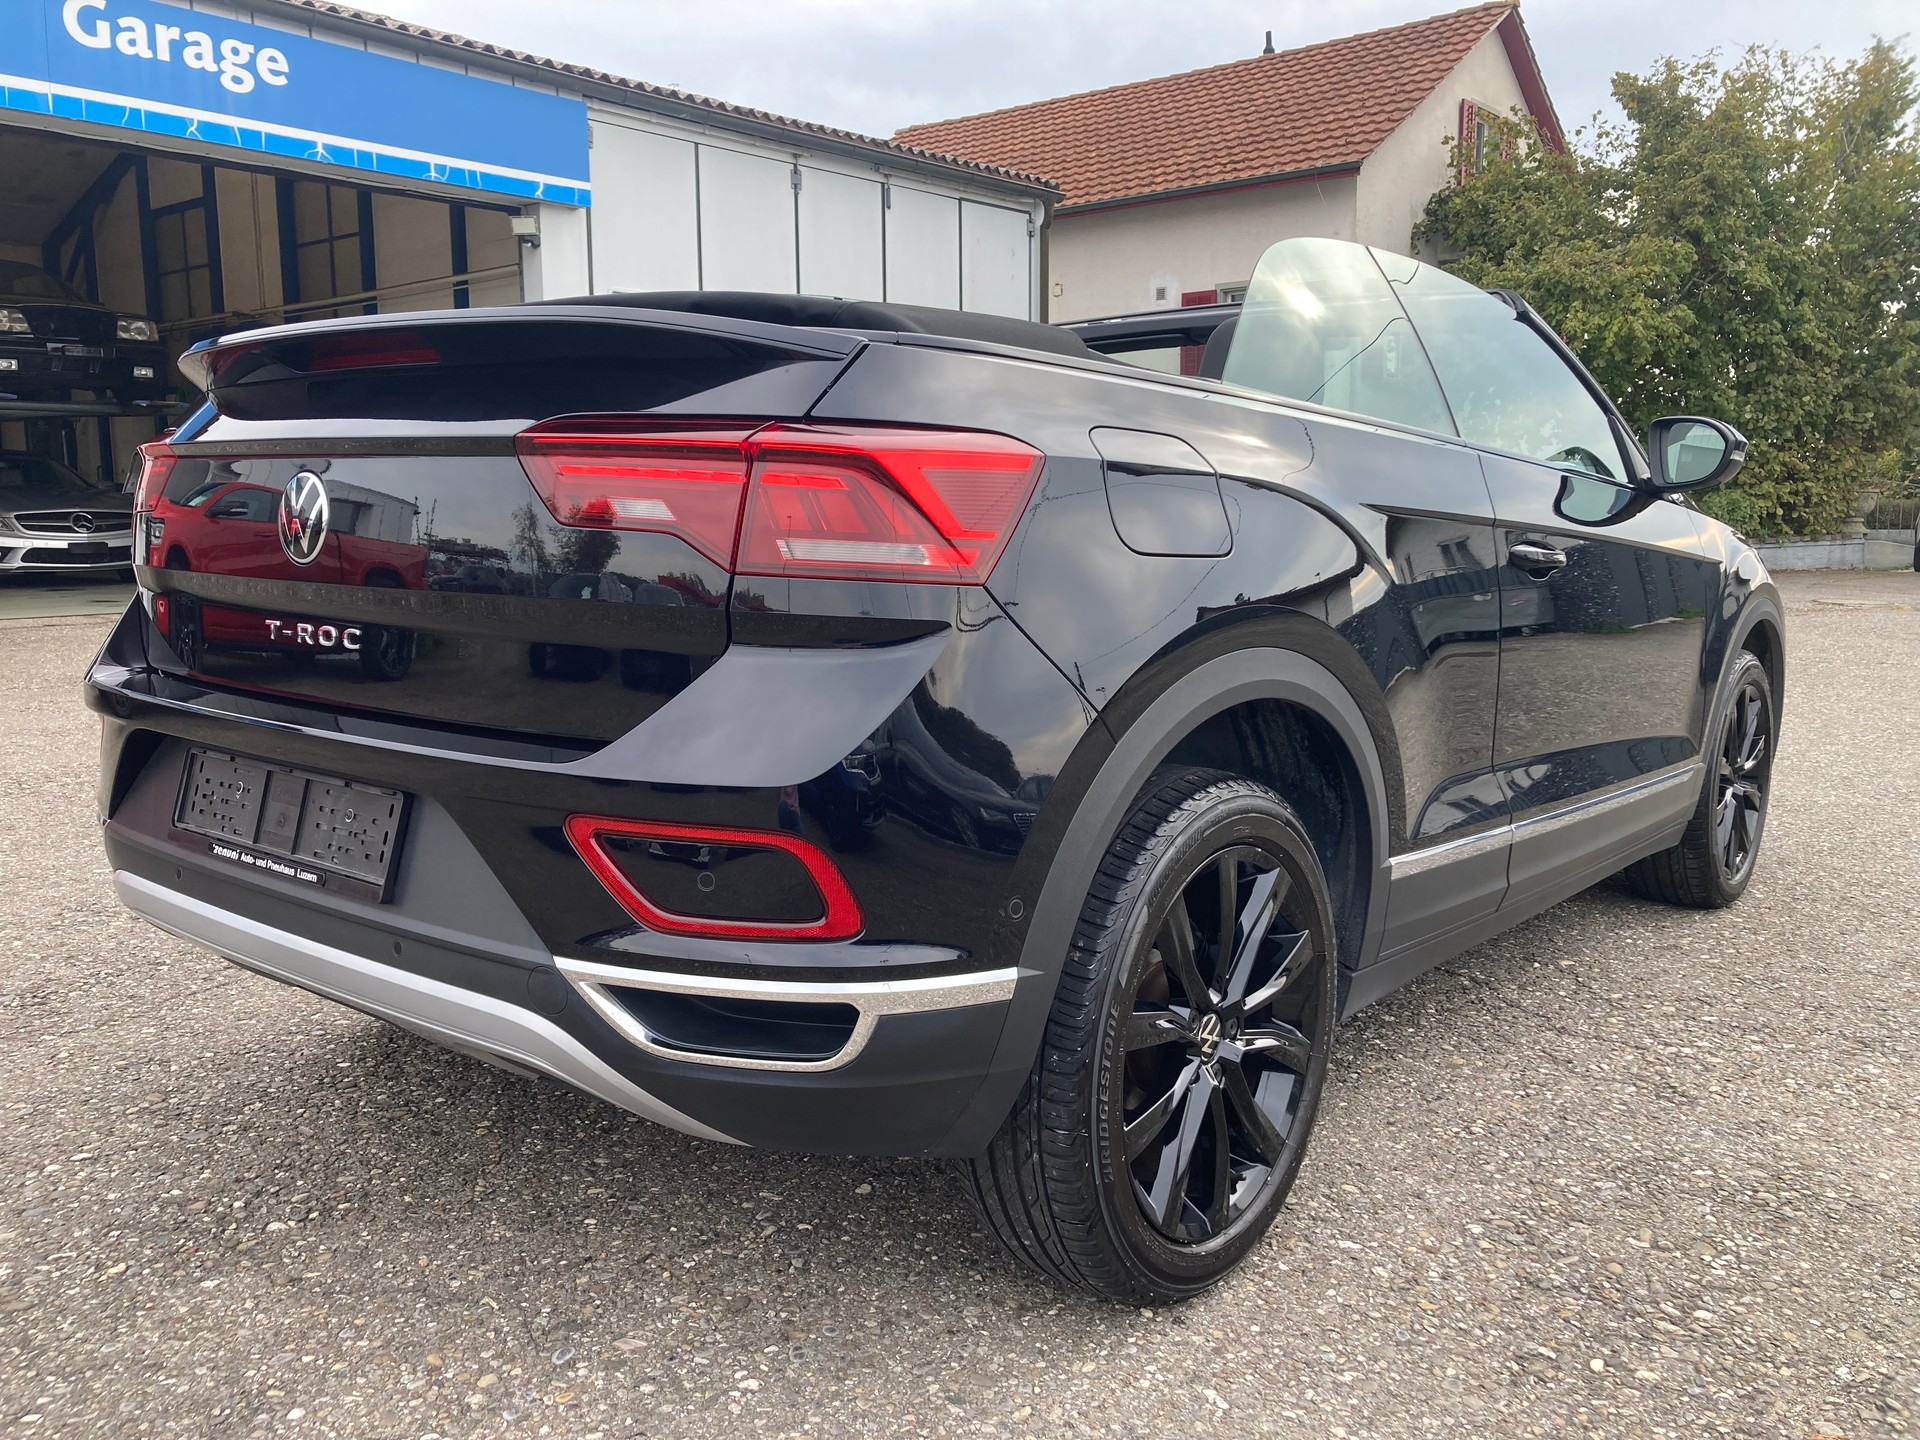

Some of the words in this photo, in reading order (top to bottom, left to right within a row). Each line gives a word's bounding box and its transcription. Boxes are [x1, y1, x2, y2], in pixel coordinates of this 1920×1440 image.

[62, 0, 290, 94] Garage
[265, 619, 361, 649] T-ROC
[240, 852, 255, 864] Auto-
[256, 858, 267, 868] und
[267, 860, 295, 876] Pneuhaus
[297, 868, 318, 882] Luzern
[1099, 1002, 1119, 1183] BRIDGESTONE
